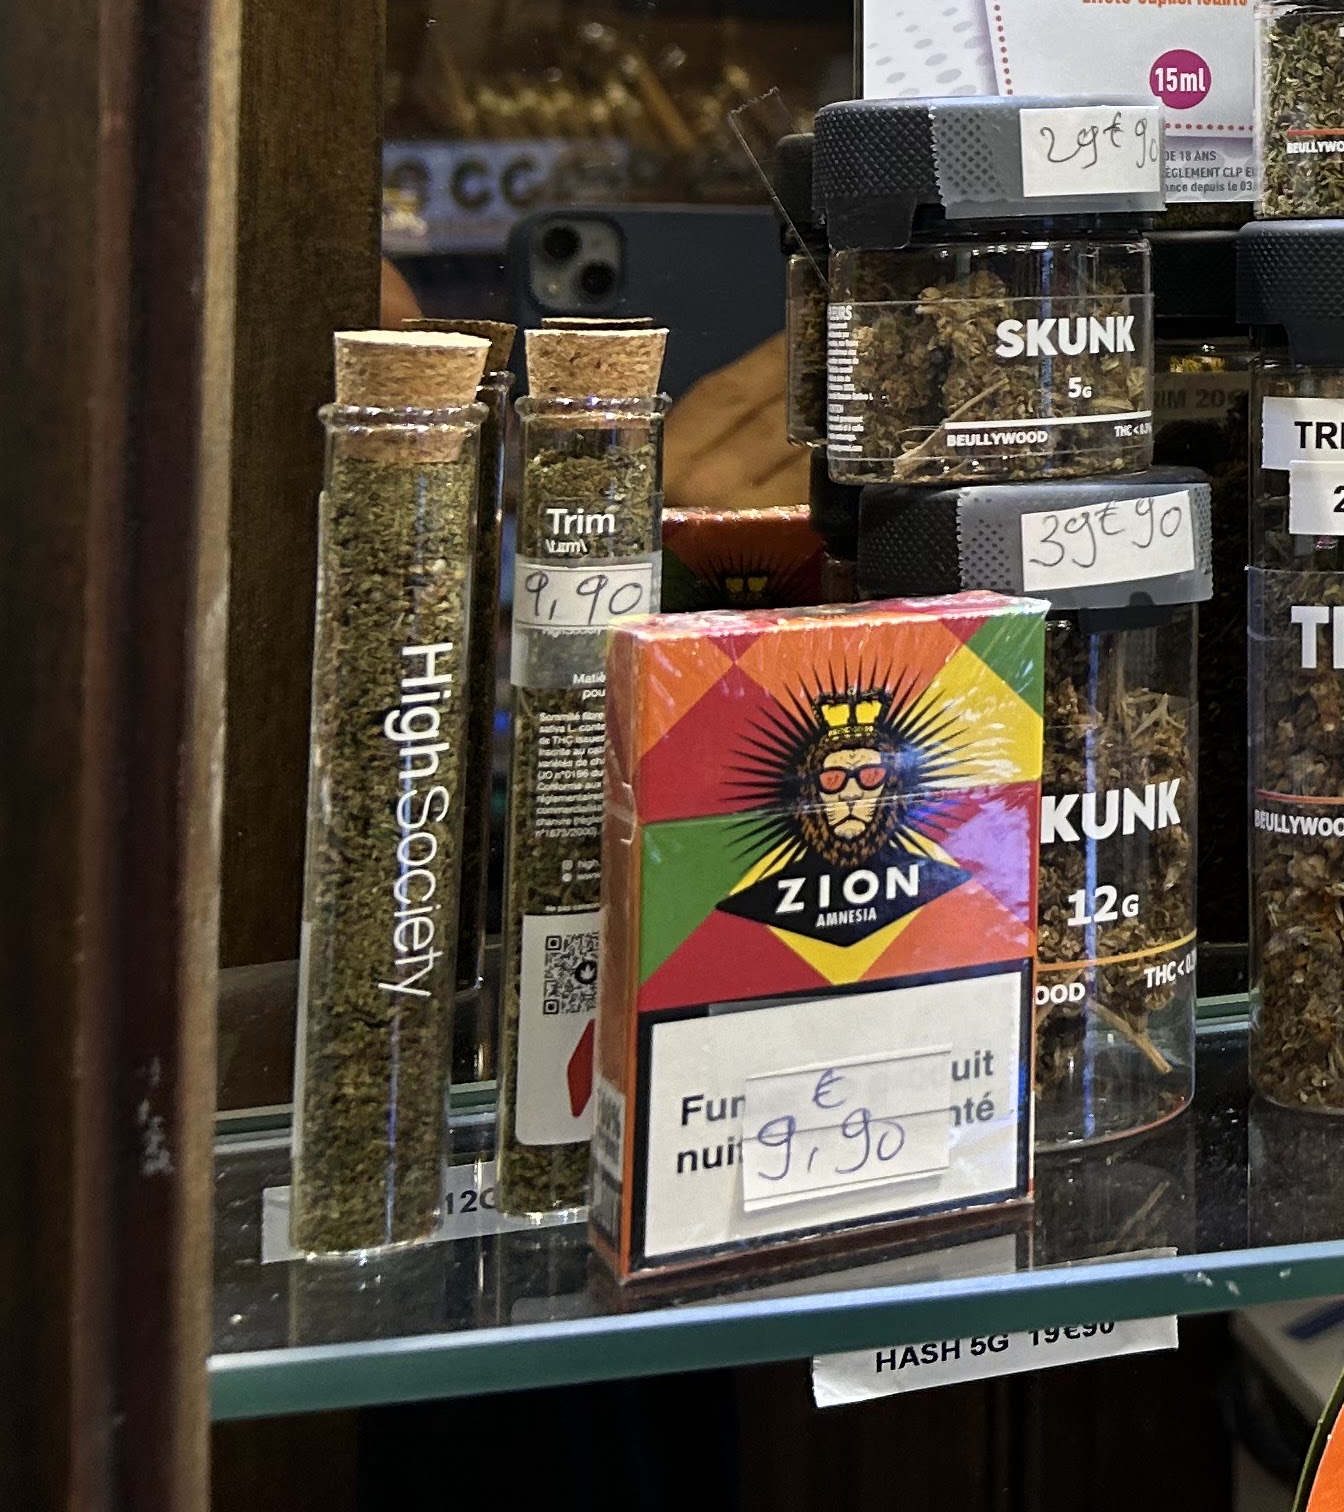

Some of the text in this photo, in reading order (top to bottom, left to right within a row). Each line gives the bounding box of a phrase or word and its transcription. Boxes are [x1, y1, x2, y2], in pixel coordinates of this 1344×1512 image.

[1155, 66, 1206, 93] 15ml
[996, 315, 1135, 358] SKUNK
[1068, 376, 1092, 399] 5G
[946, 430, 1048, 447] BEULLYWOOD
[546, 507, 616, 537] Trim
[775, 863, 920, 914] ZION
[1067, 884, 1139, 927] 12G
[816, 907, 877, 928] AMNESIA
[757, 1107, 906, 1182] 9,90
[876, 1333, 1009, 1373] HASH 5G
